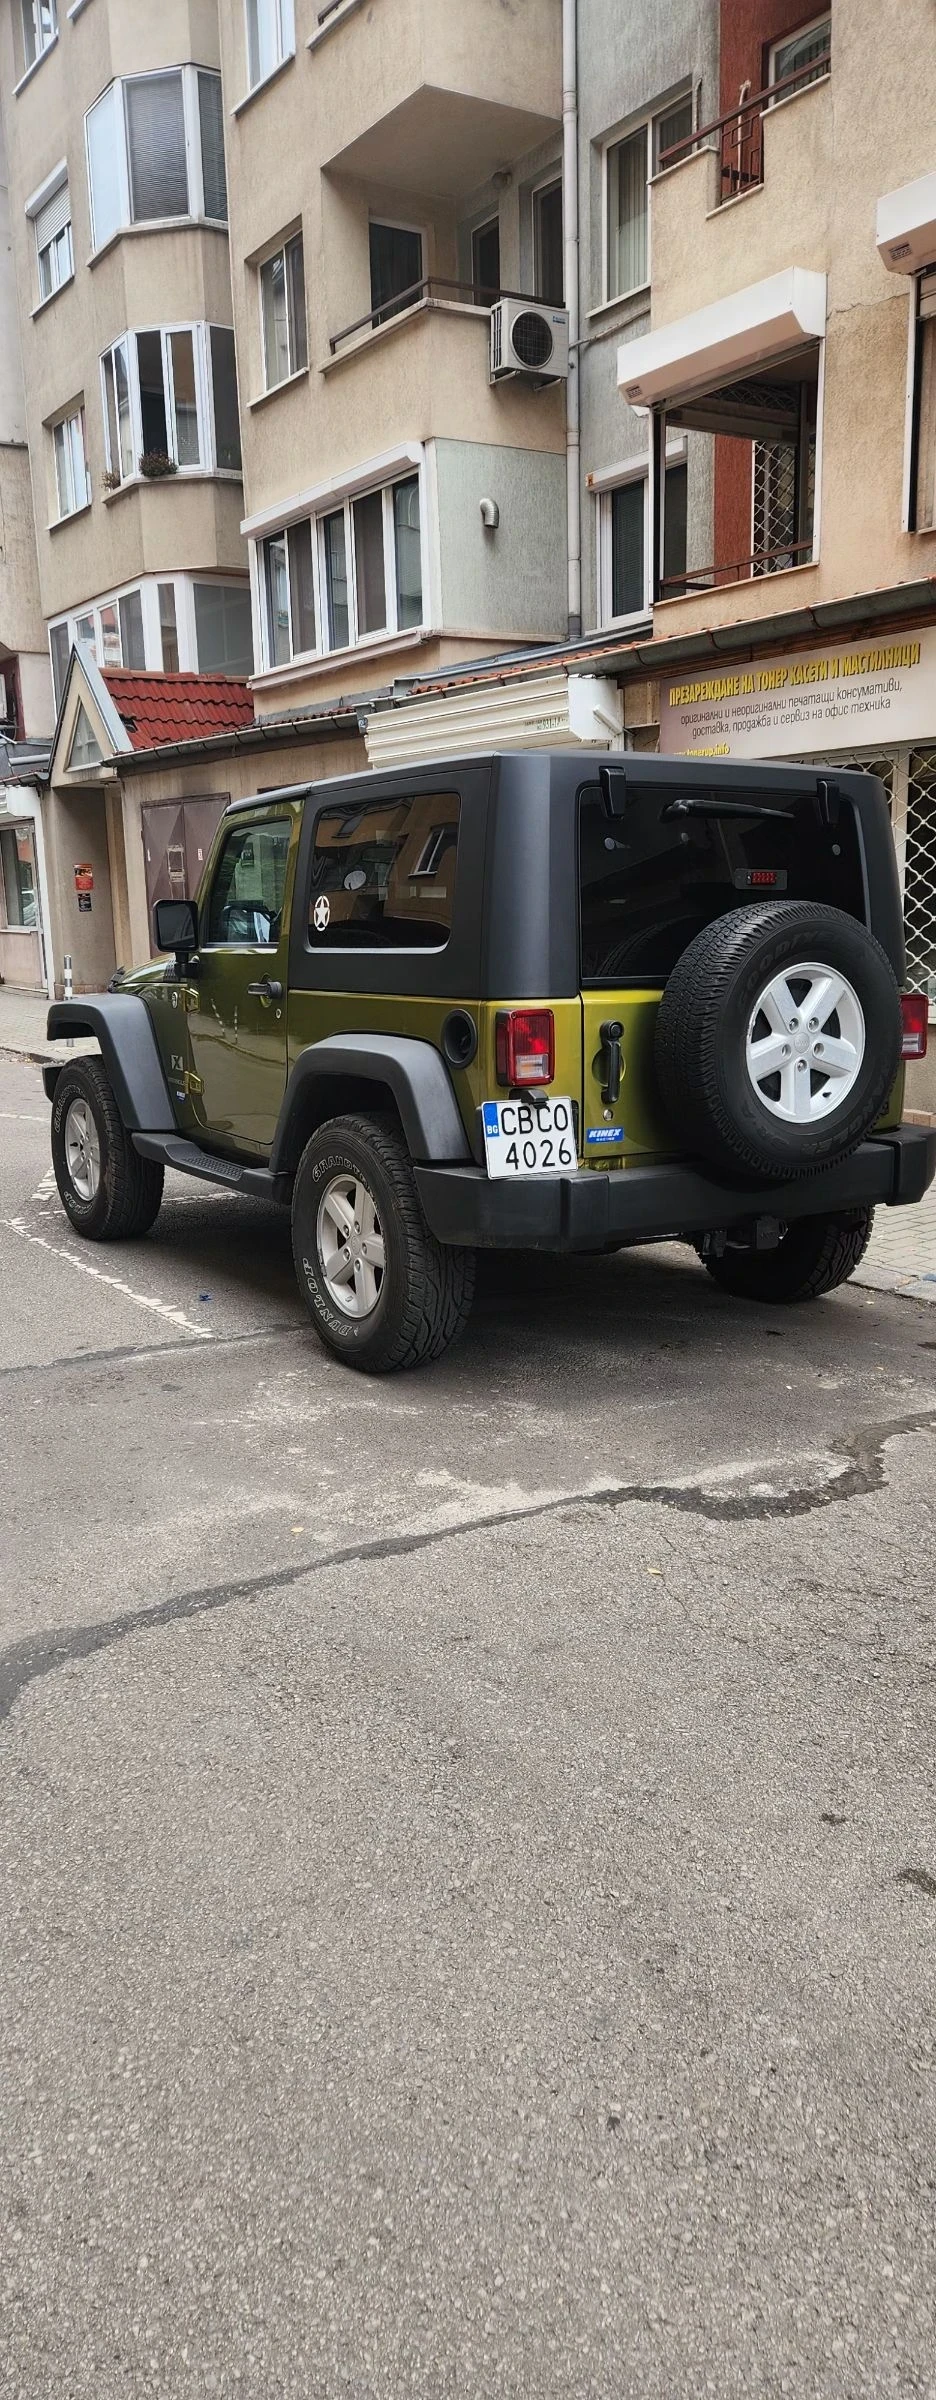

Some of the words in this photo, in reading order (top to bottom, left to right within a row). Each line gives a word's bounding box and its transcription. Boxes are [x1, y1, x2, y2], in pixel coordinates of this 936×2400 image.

[669, 676, 740, 707] ПРЕЗАРЕЖДАНЕ
[742, 673, 755, 694] НА
[756, 668, 788, 691] ТОНЕР
[788, 660, 829, 686] КАСЕТИ
[832, 658, 840, 679] И
[843, 642, 921, 677] МАСТИЛНИЦИ
[681, 710, 723, 726] оригинални
[725, 710, 730, 718] и
[732, 701, 787, 719] неоригинални
[788, 690, 834, 708] печатащи
[837, 677, 903, 699] консумативи,
[693, 721, 731, 739] доставка,
[733, 715, 771, 732] продажба
[774, 716, 779, 725] и
[781, 708, 810, 725] сервиз
[812, 709, 822, 720] на
[825, 703, 848, 720] офис
[851, 696, 891, 715] техника
[487, 1125, 498, 1134] BG
[501, 1104, 568, 1135] CBCO
[589, 1129, 621, 1138] KINEX
[506, 1138, 572, 1170] 4026
[303, 1258, 353, 1337] DUNLOP
